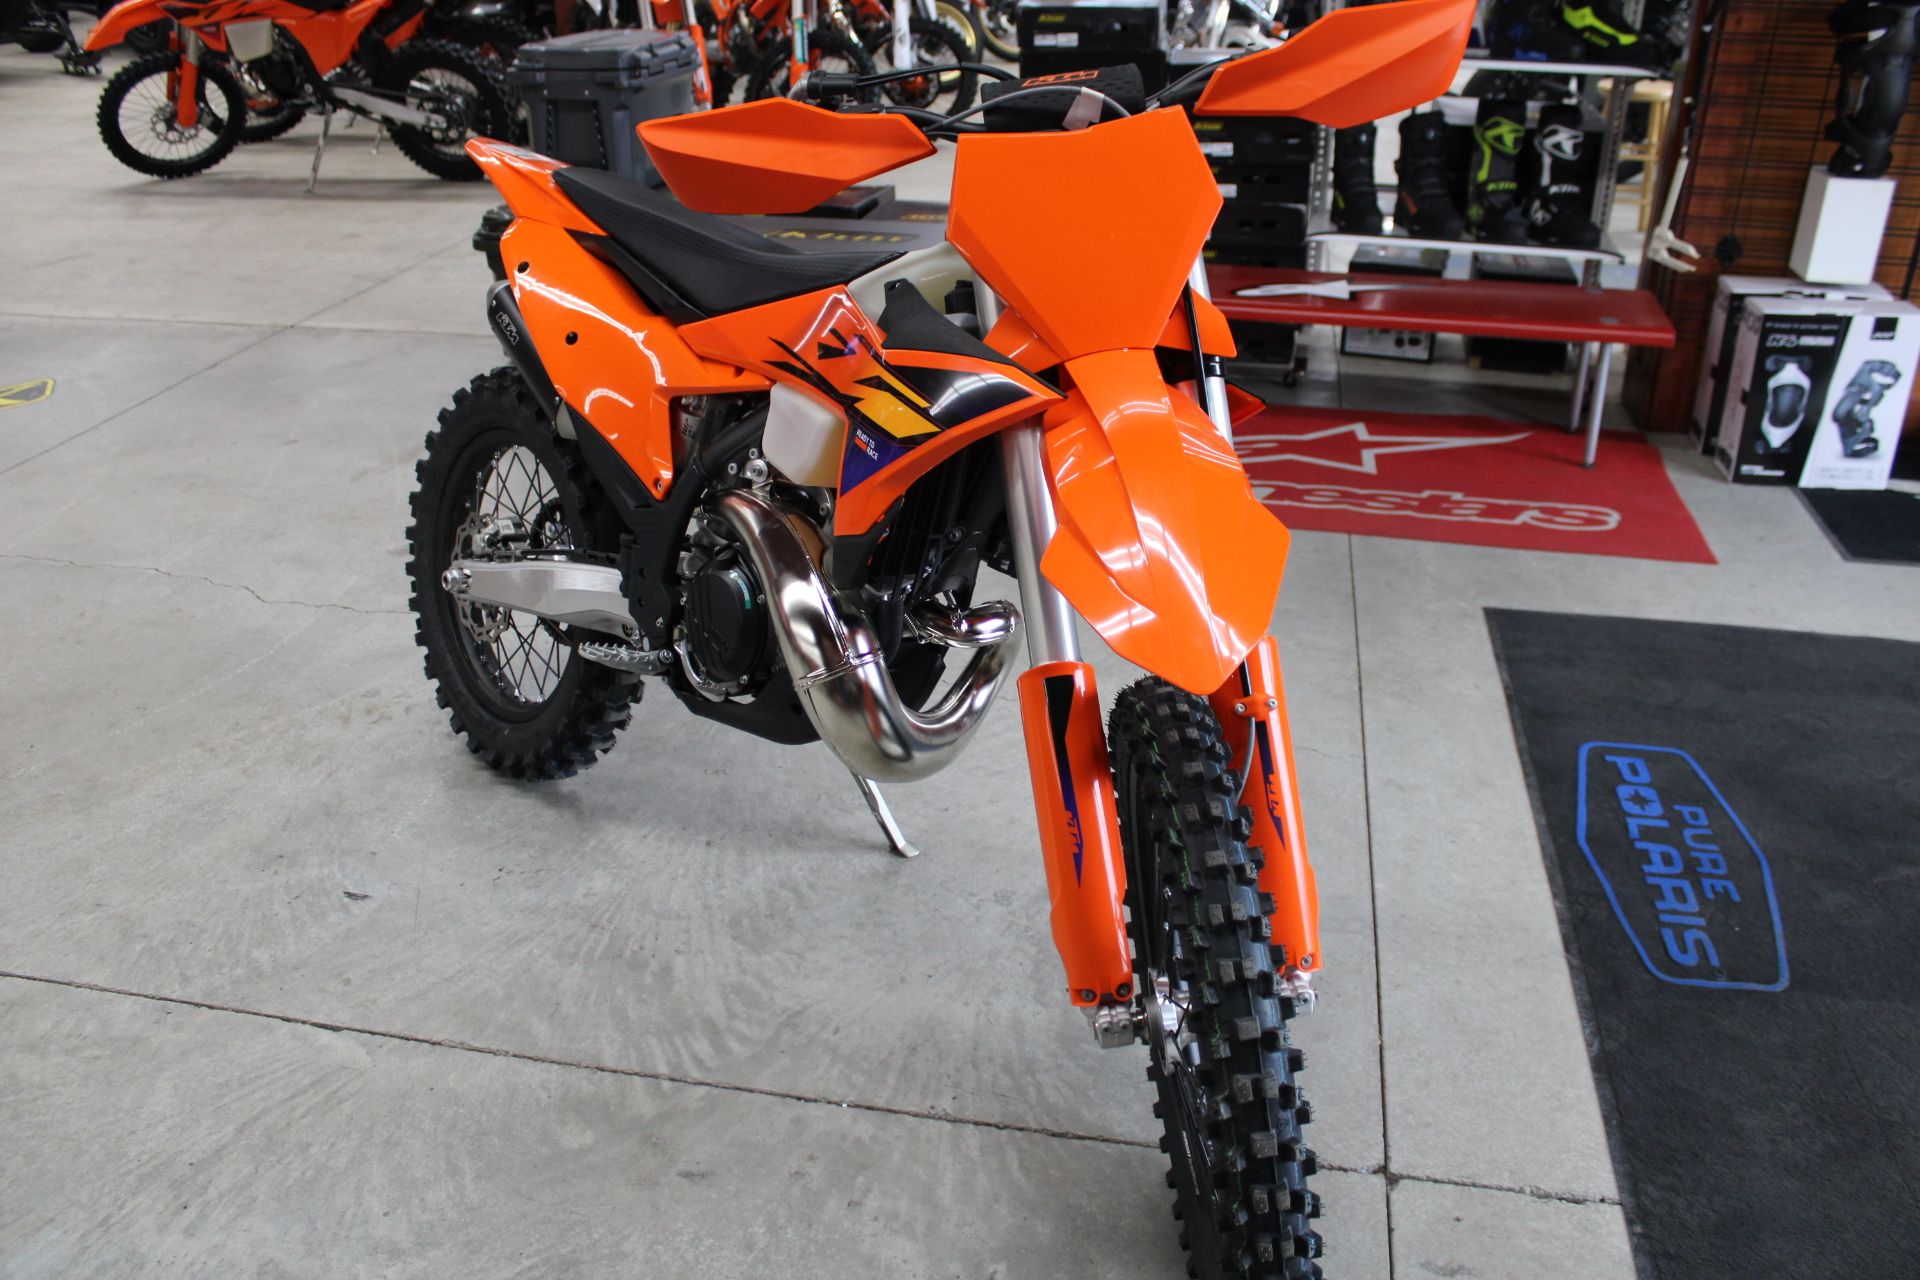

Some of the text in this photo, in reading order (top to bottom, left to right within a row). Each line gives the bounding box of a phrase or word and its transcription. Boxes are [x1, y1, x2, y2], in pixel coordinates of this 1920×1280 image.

[1021, 69, 1099, 87] KTM
[496, 311, 520, 346] KTM
[856, 428, 876, 449] READY TO
[866, 446, 879, 461] RACE
[1604, 754, 1721, 968] POLARIS
[1672, 804, 1741, 903] PURE
